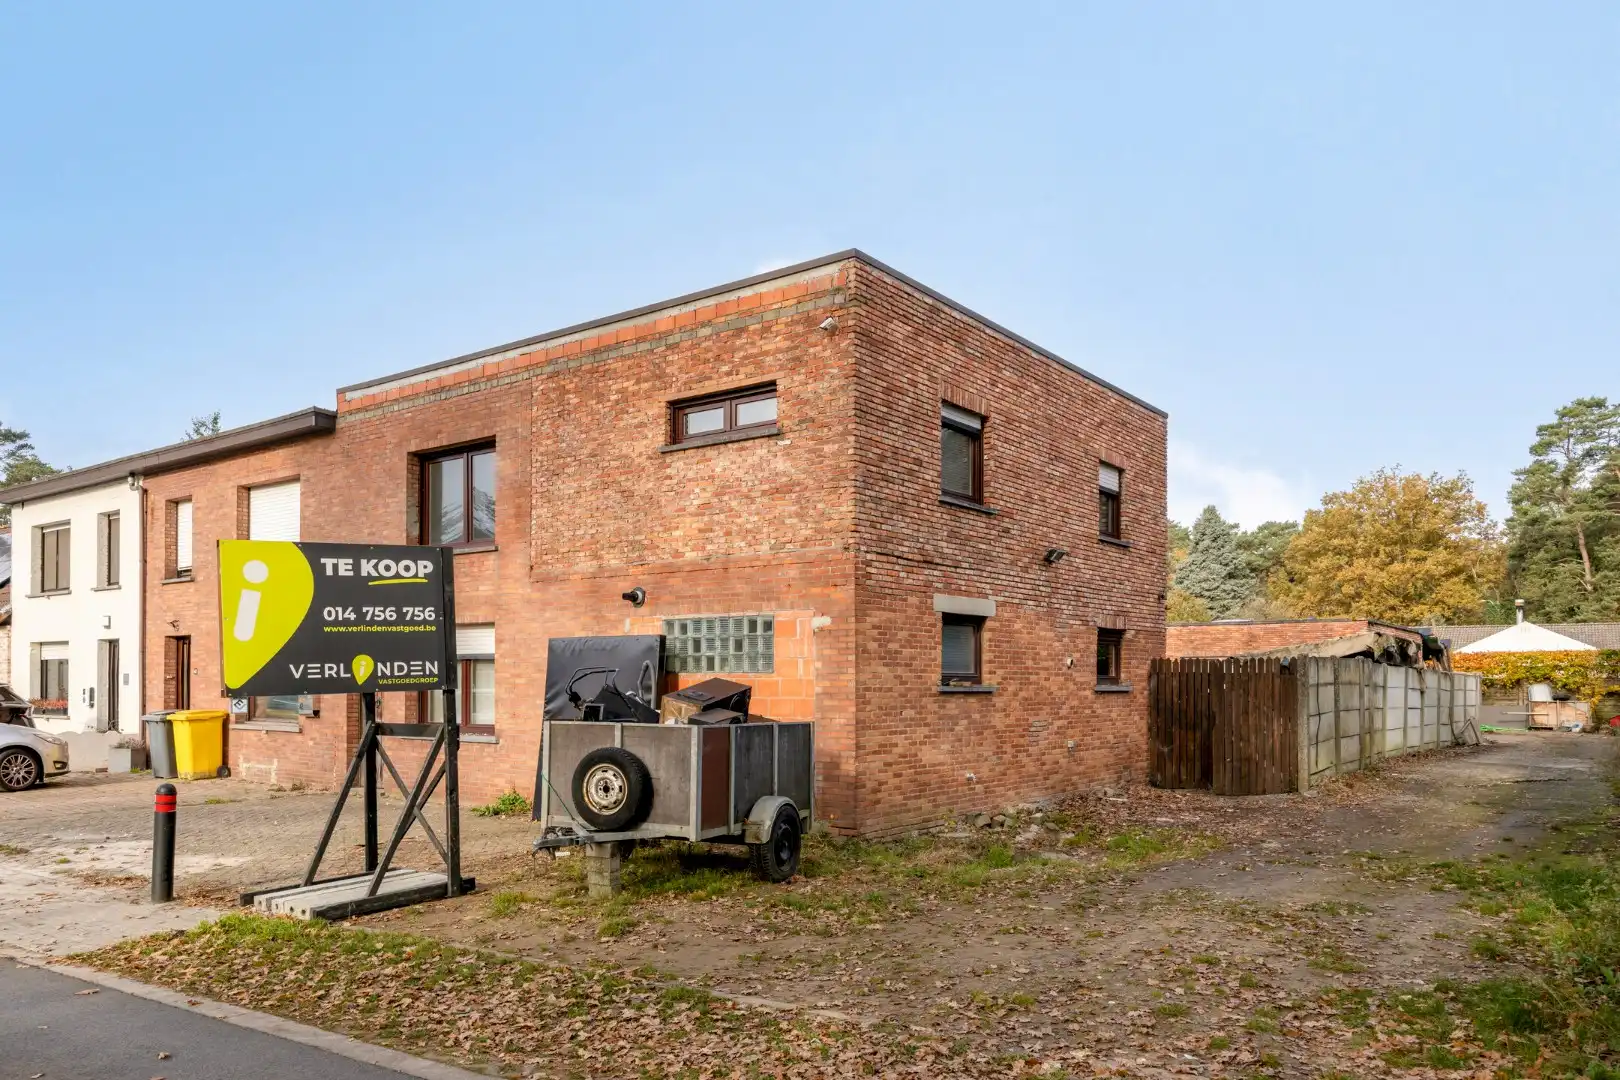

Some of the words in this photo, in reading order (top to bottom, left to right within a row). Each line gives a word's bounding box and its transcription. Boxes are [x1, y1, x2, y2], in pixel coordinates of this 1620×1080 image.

[320, 557, 354, 576] TE
[360, 558, 434, 578] KOOP
[323, 606, 357, 621] 014
[362, 606, 398, 621] 756
[402, 606, 436, 621] 756
[323, 624, 437, 633] www.verlindenvastgoed.be
[378, 676, 439, 686] VASTGOEDGROEP
